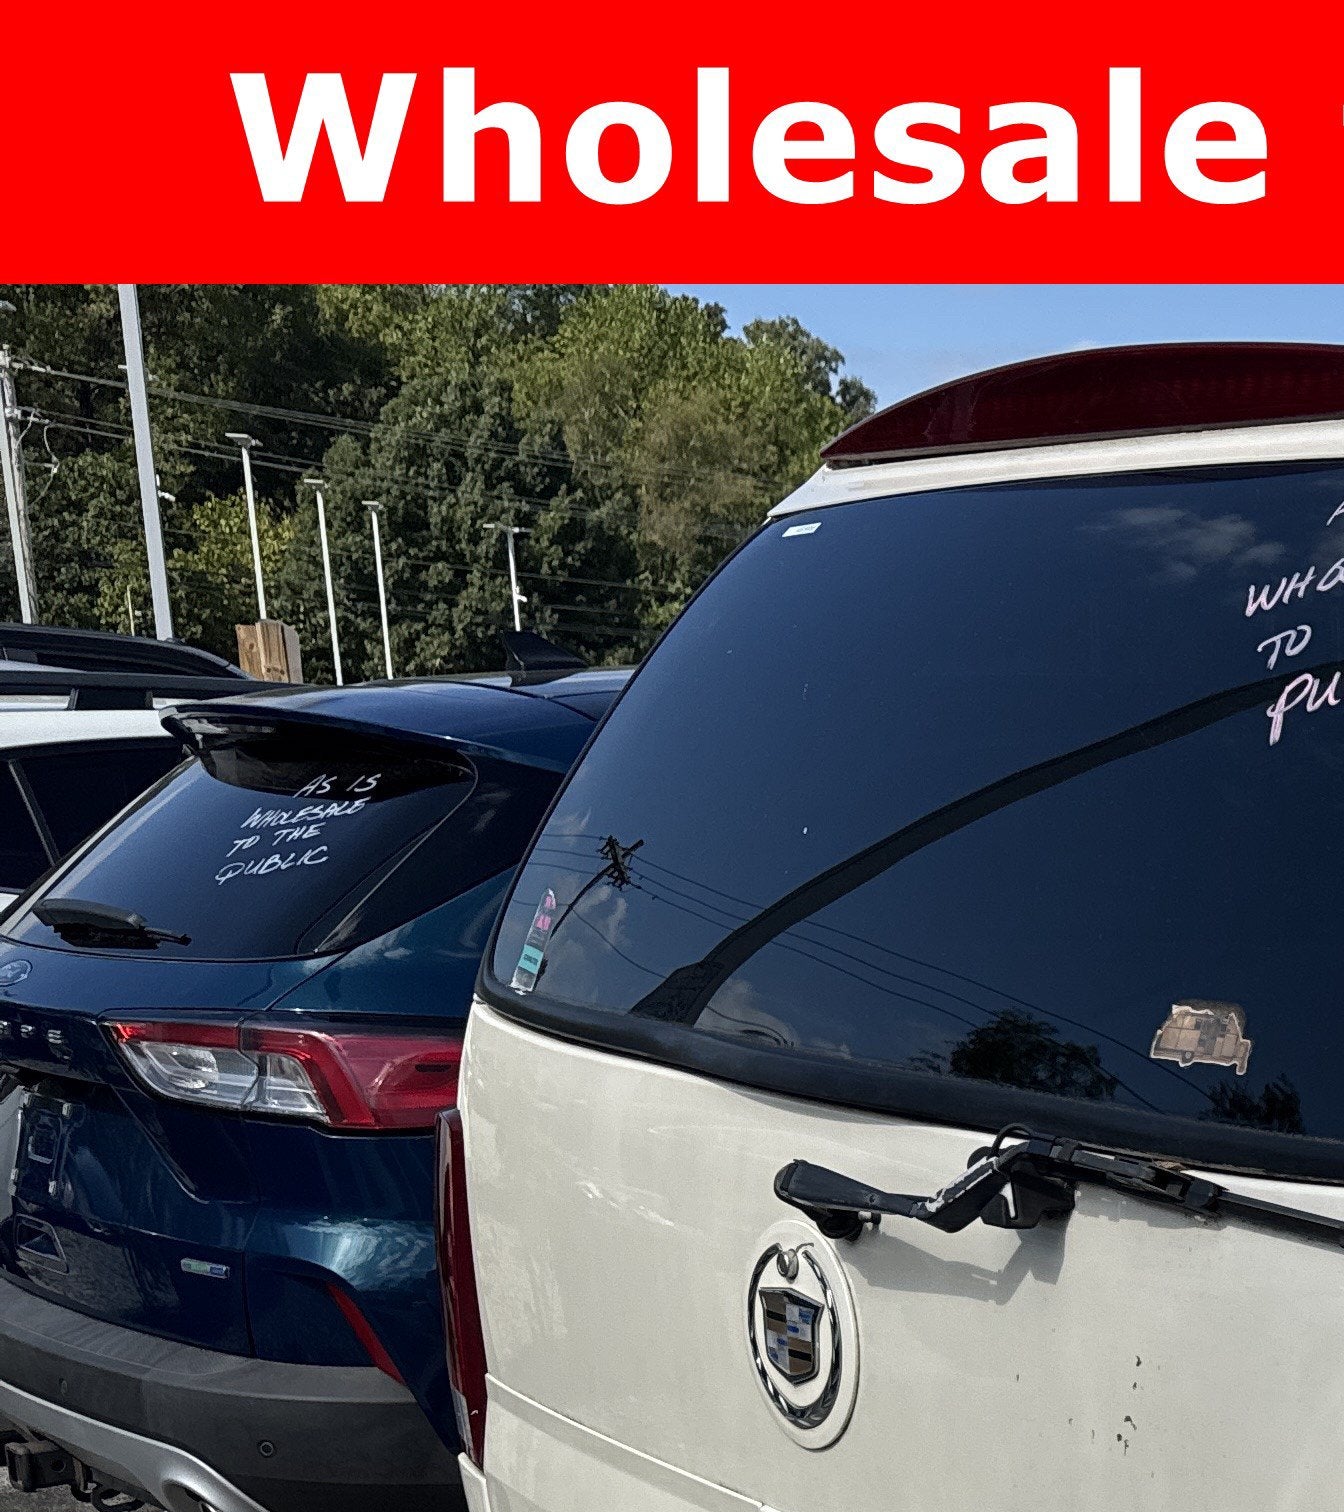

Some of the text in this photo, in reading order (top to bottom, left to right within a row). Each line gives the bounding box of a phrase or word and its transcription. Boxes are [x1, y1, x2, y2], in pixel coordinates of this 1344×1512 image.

[1256, 624, 1312, 670] TO
[292, 773, 382, 798] AS IS
[240, 796, 372, 829] WHOLESALE
[225, 821, 327, 858] TO THE
[214, 845, 329, 886] PUBLIC
